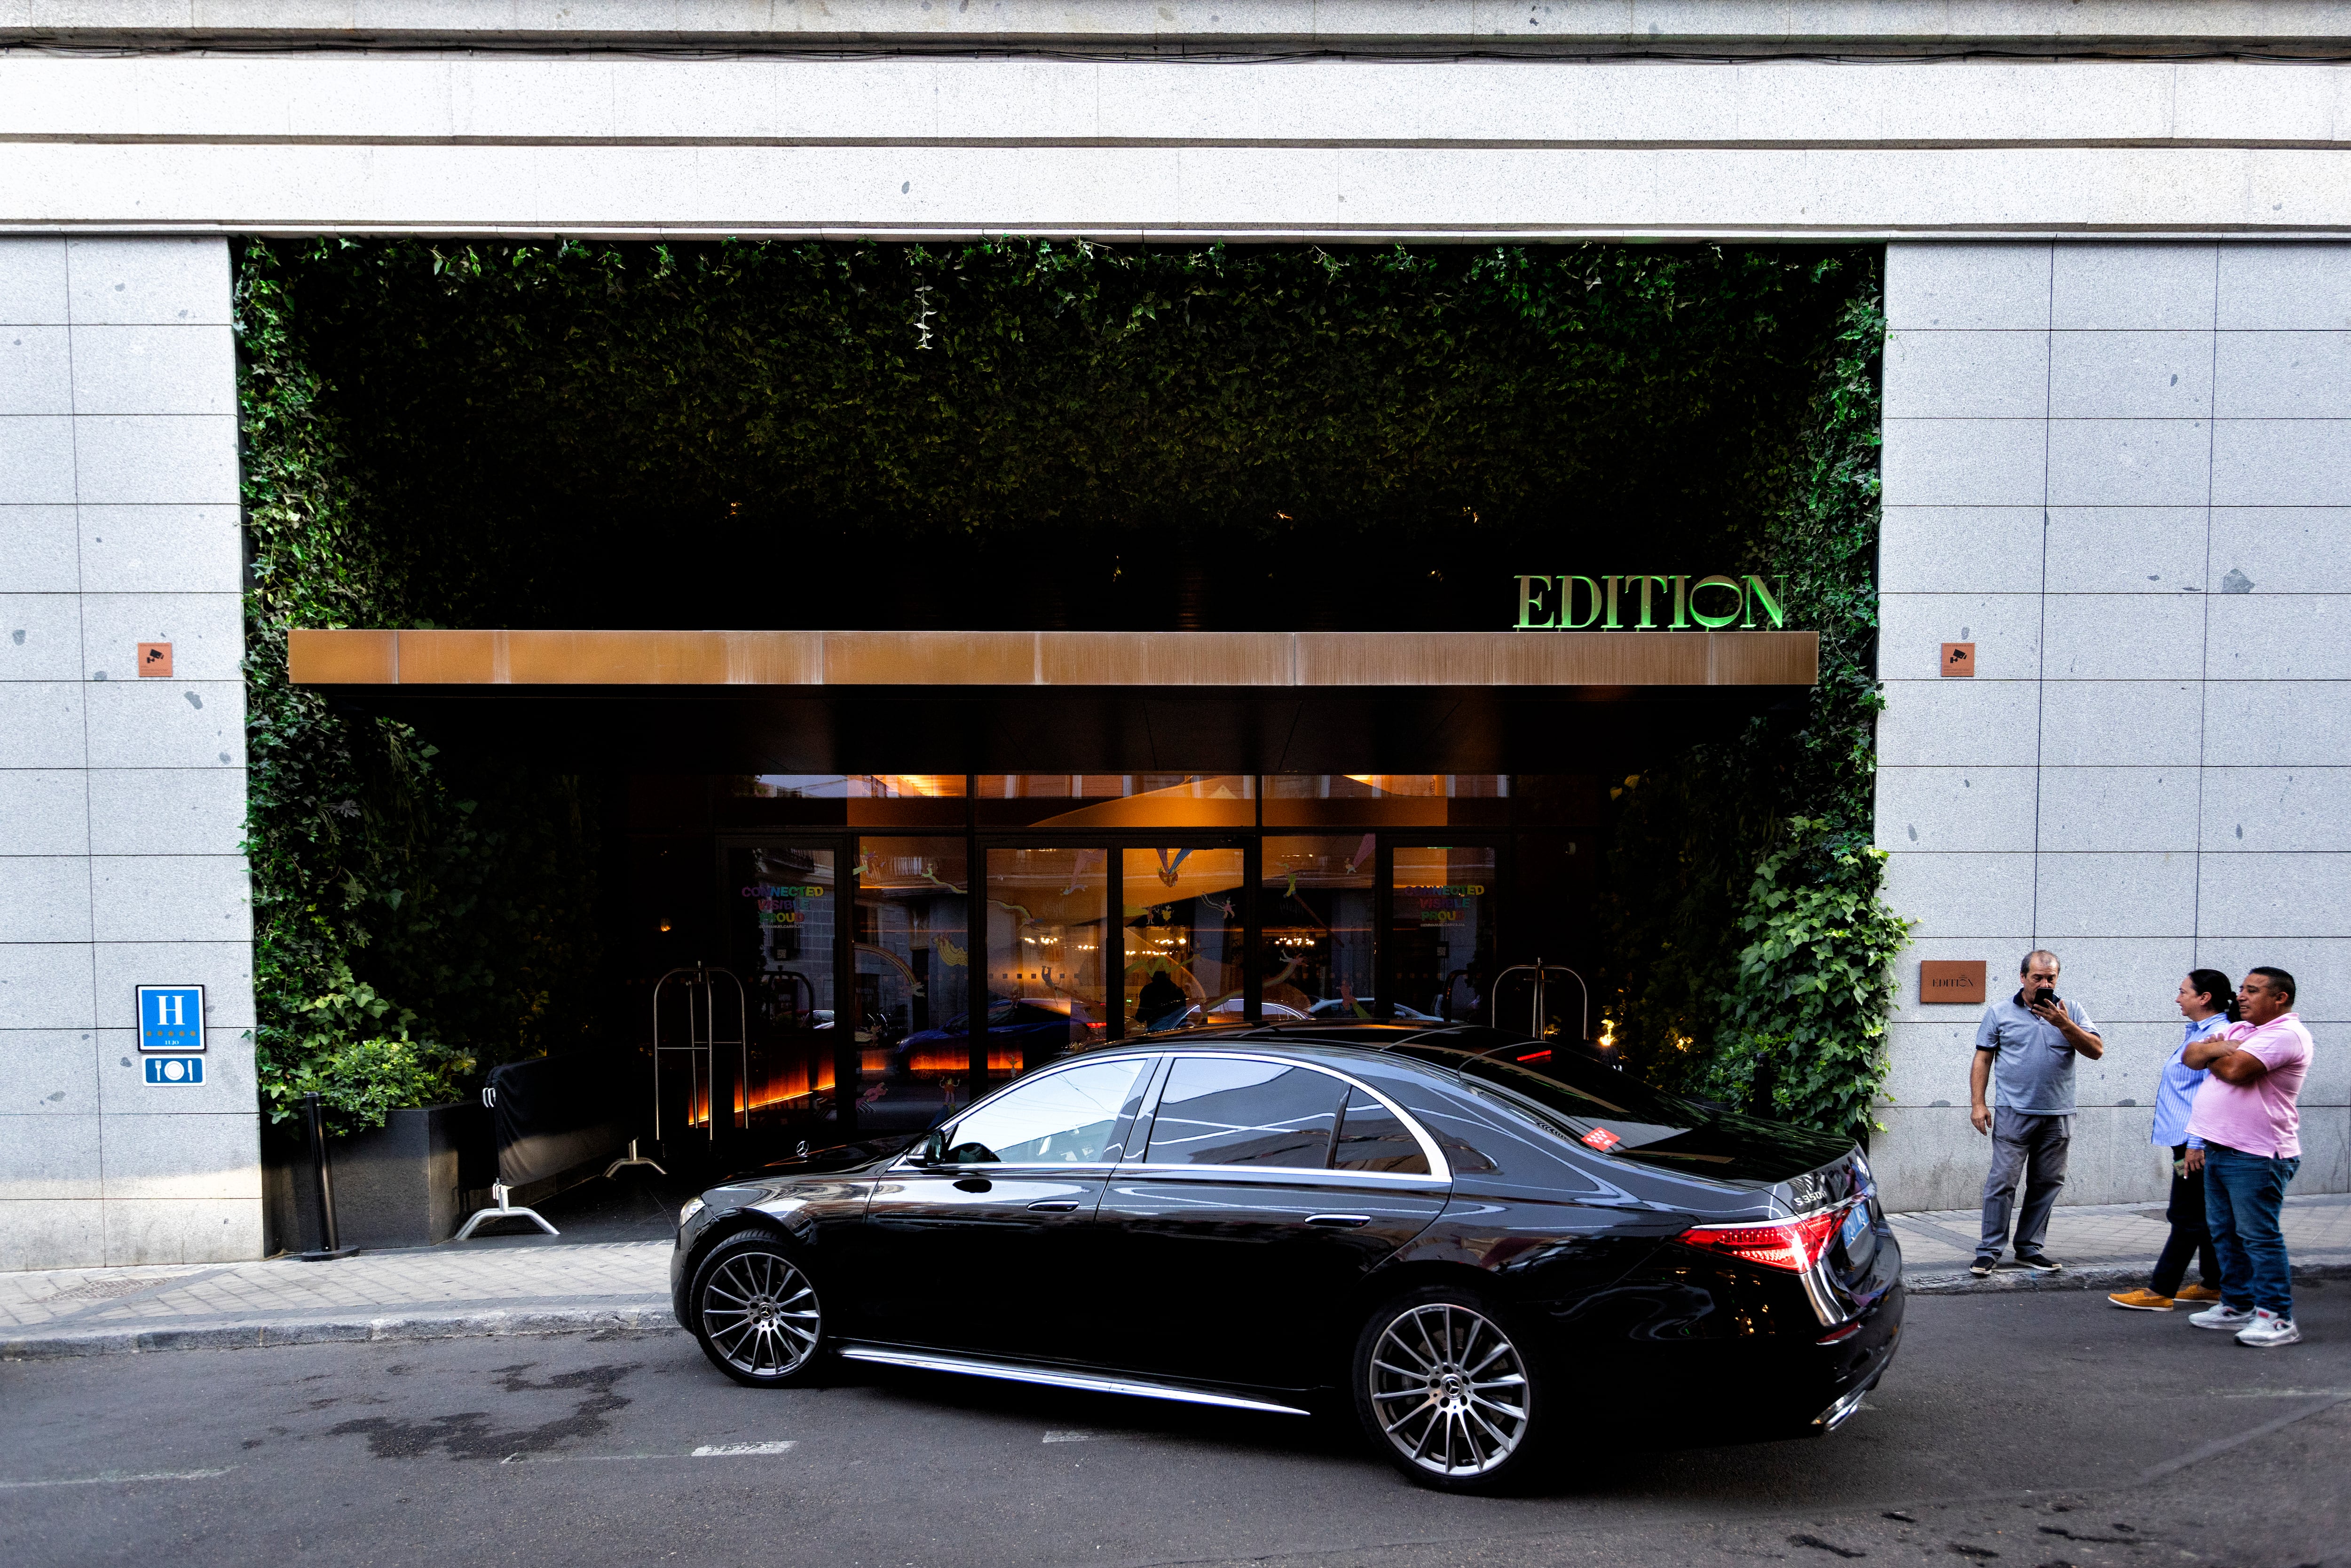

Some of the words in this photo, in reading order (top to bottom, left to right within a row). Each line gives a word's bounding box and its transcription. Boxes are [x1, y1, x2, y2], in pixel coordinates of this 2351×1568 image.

[1512, 575, 1789, 628] EDITION
[742, 886, 824, 897] CONNECTED
[1404, 885, 1485, 895] CONNECTED
[757, 898, 810, 910] VISIBLE
[1420, 898, 1471, 908] VISIBLE
[759, 912, 805, 923] PROUD
[1421, 910, 1465, 921] PROUD
[1933, 978, 1973, 987] EDITION
[156, 995, 186, 1025] H
